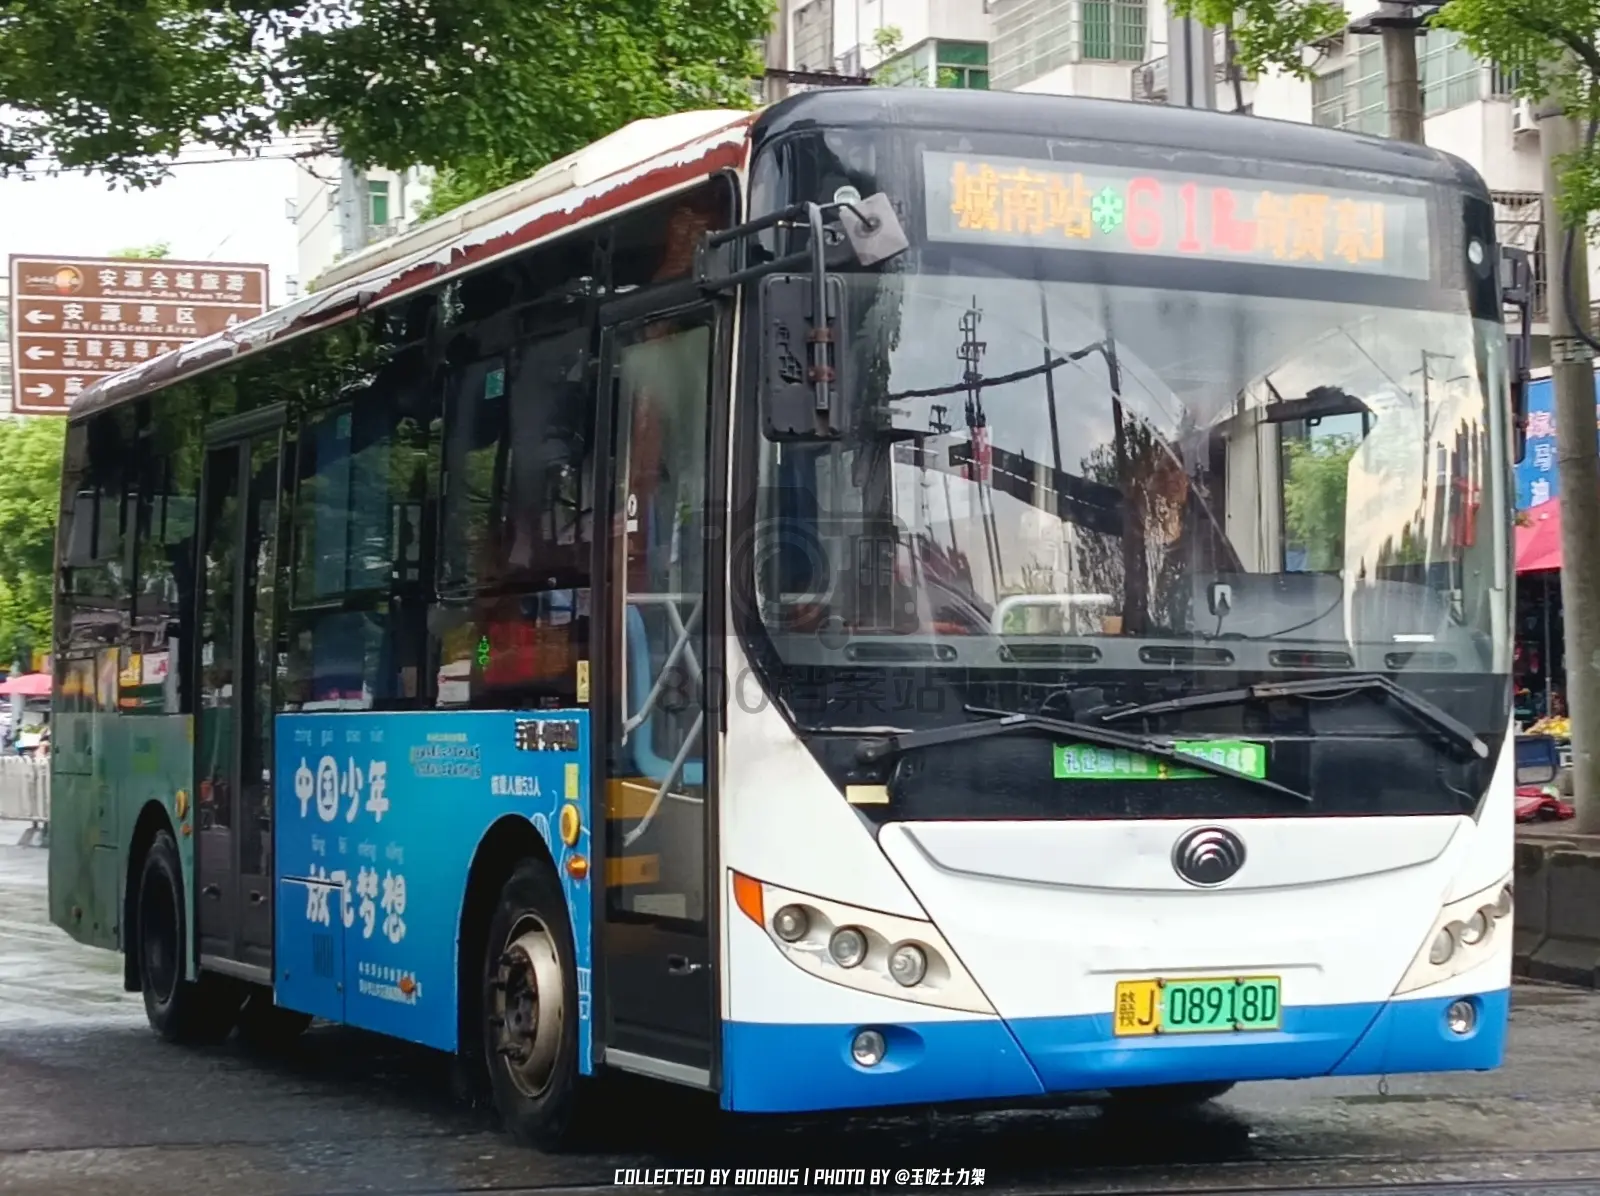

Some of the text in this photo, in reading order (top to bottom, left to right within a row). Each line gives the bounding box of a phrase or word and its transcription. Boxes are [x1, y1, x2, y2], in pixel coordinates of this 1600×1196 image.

[951, 161, 1091, 239] 城南站
[61, 320, 197, 335] An Yuan Scenic Area
[62, 302, 196, 325] 安源景区
[295, 755, 390, 823] 中国少年
[305, 862, 406, 944] 放飞梦想
[1170, 984, 1277, 1025] 08918D
